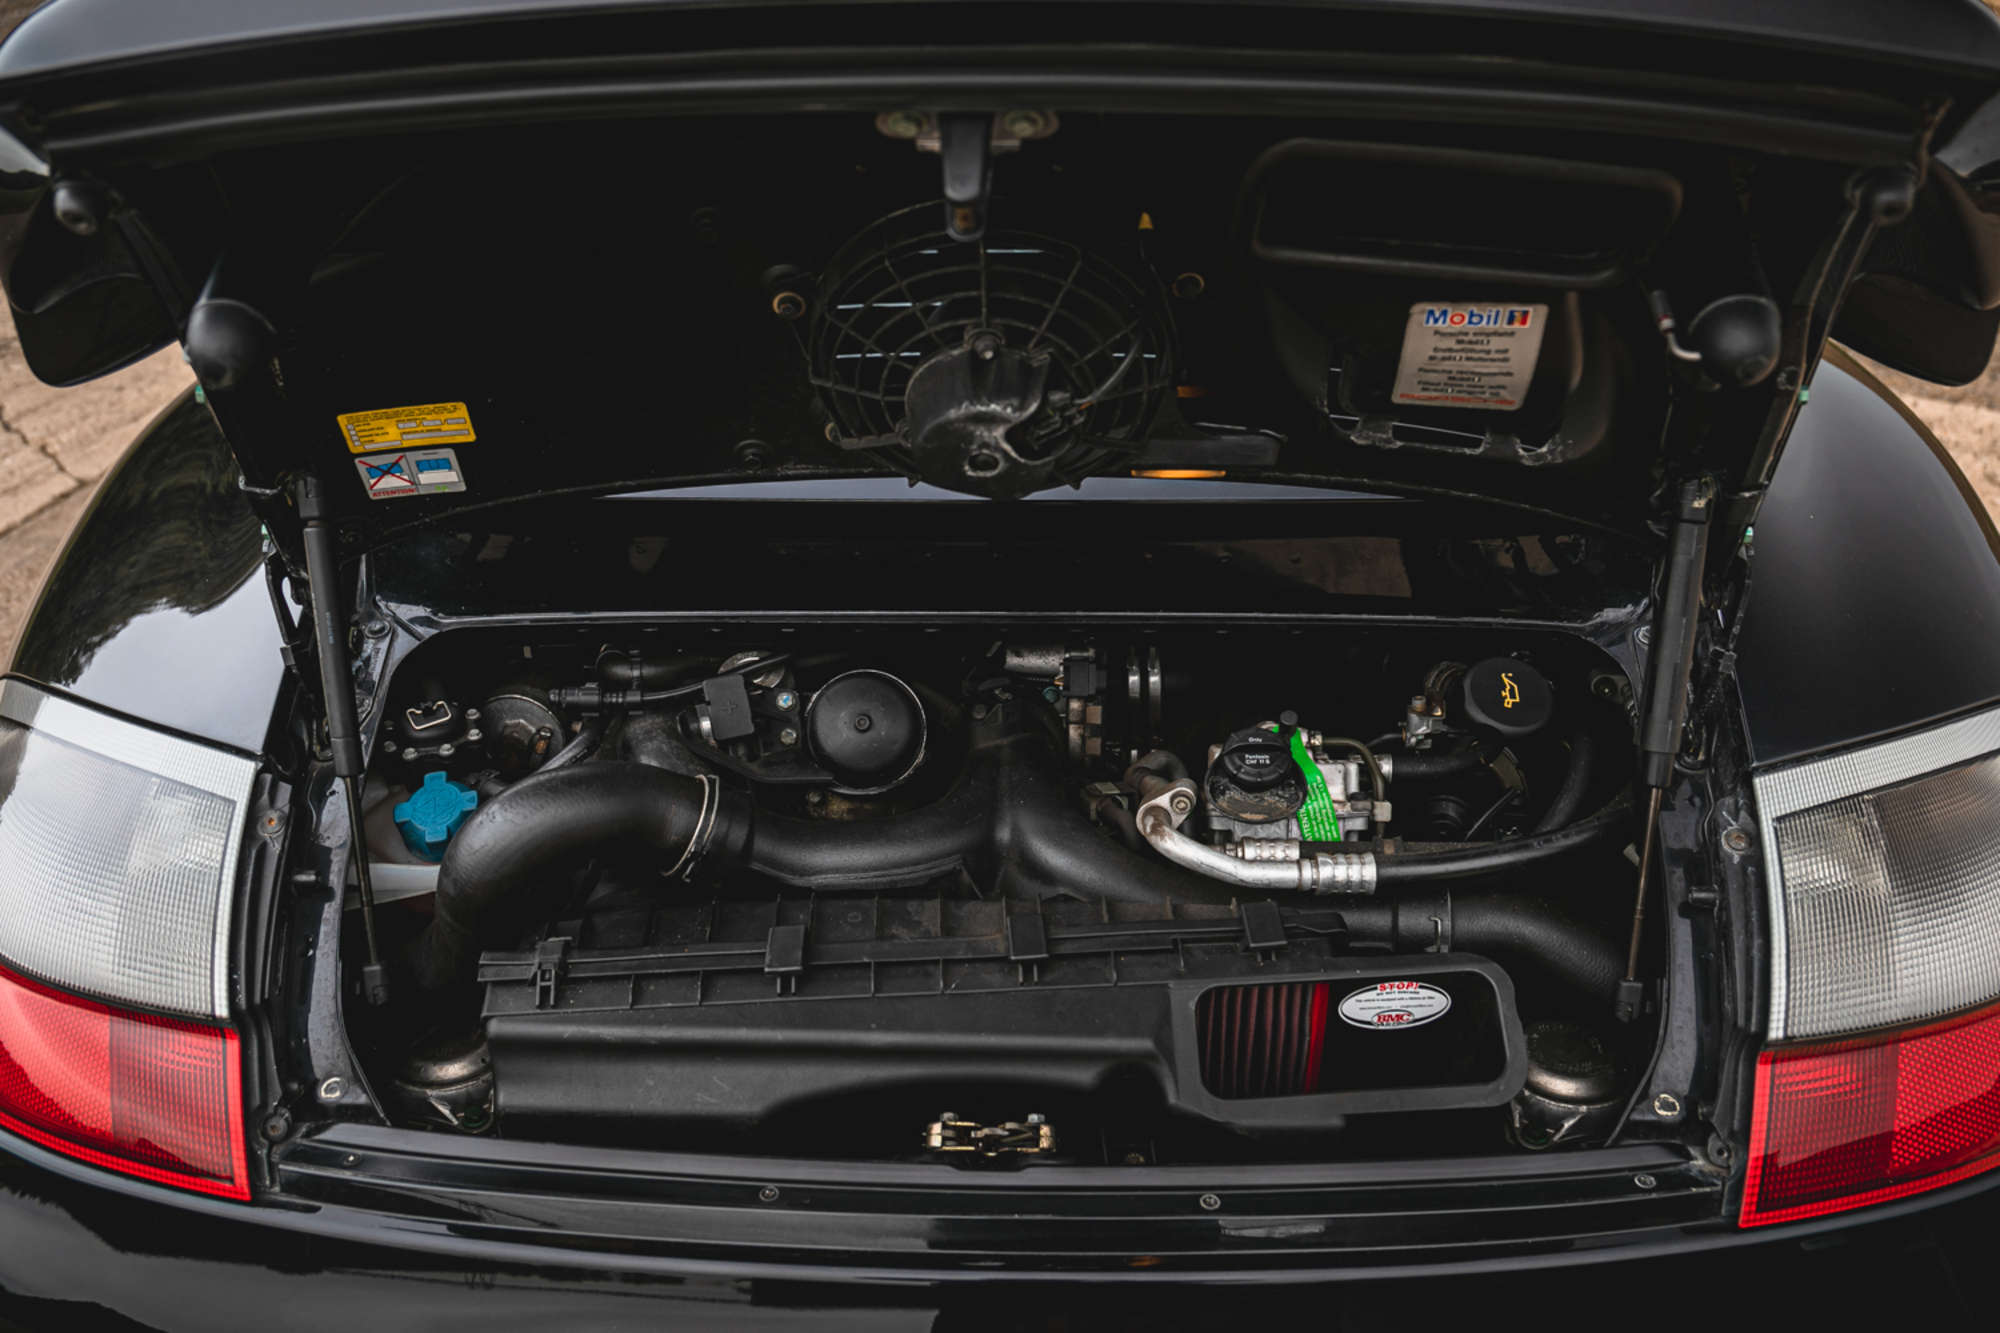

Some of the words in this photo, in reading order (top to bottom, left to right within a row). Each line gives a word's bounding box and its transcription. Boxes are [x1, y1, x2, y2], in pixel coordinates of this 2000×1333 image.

[1424, 308, 1501, 327] Mobil
[1379, 982, 1420, 991] STOP!
[1376, 1013, 1411, 1023] BMC
